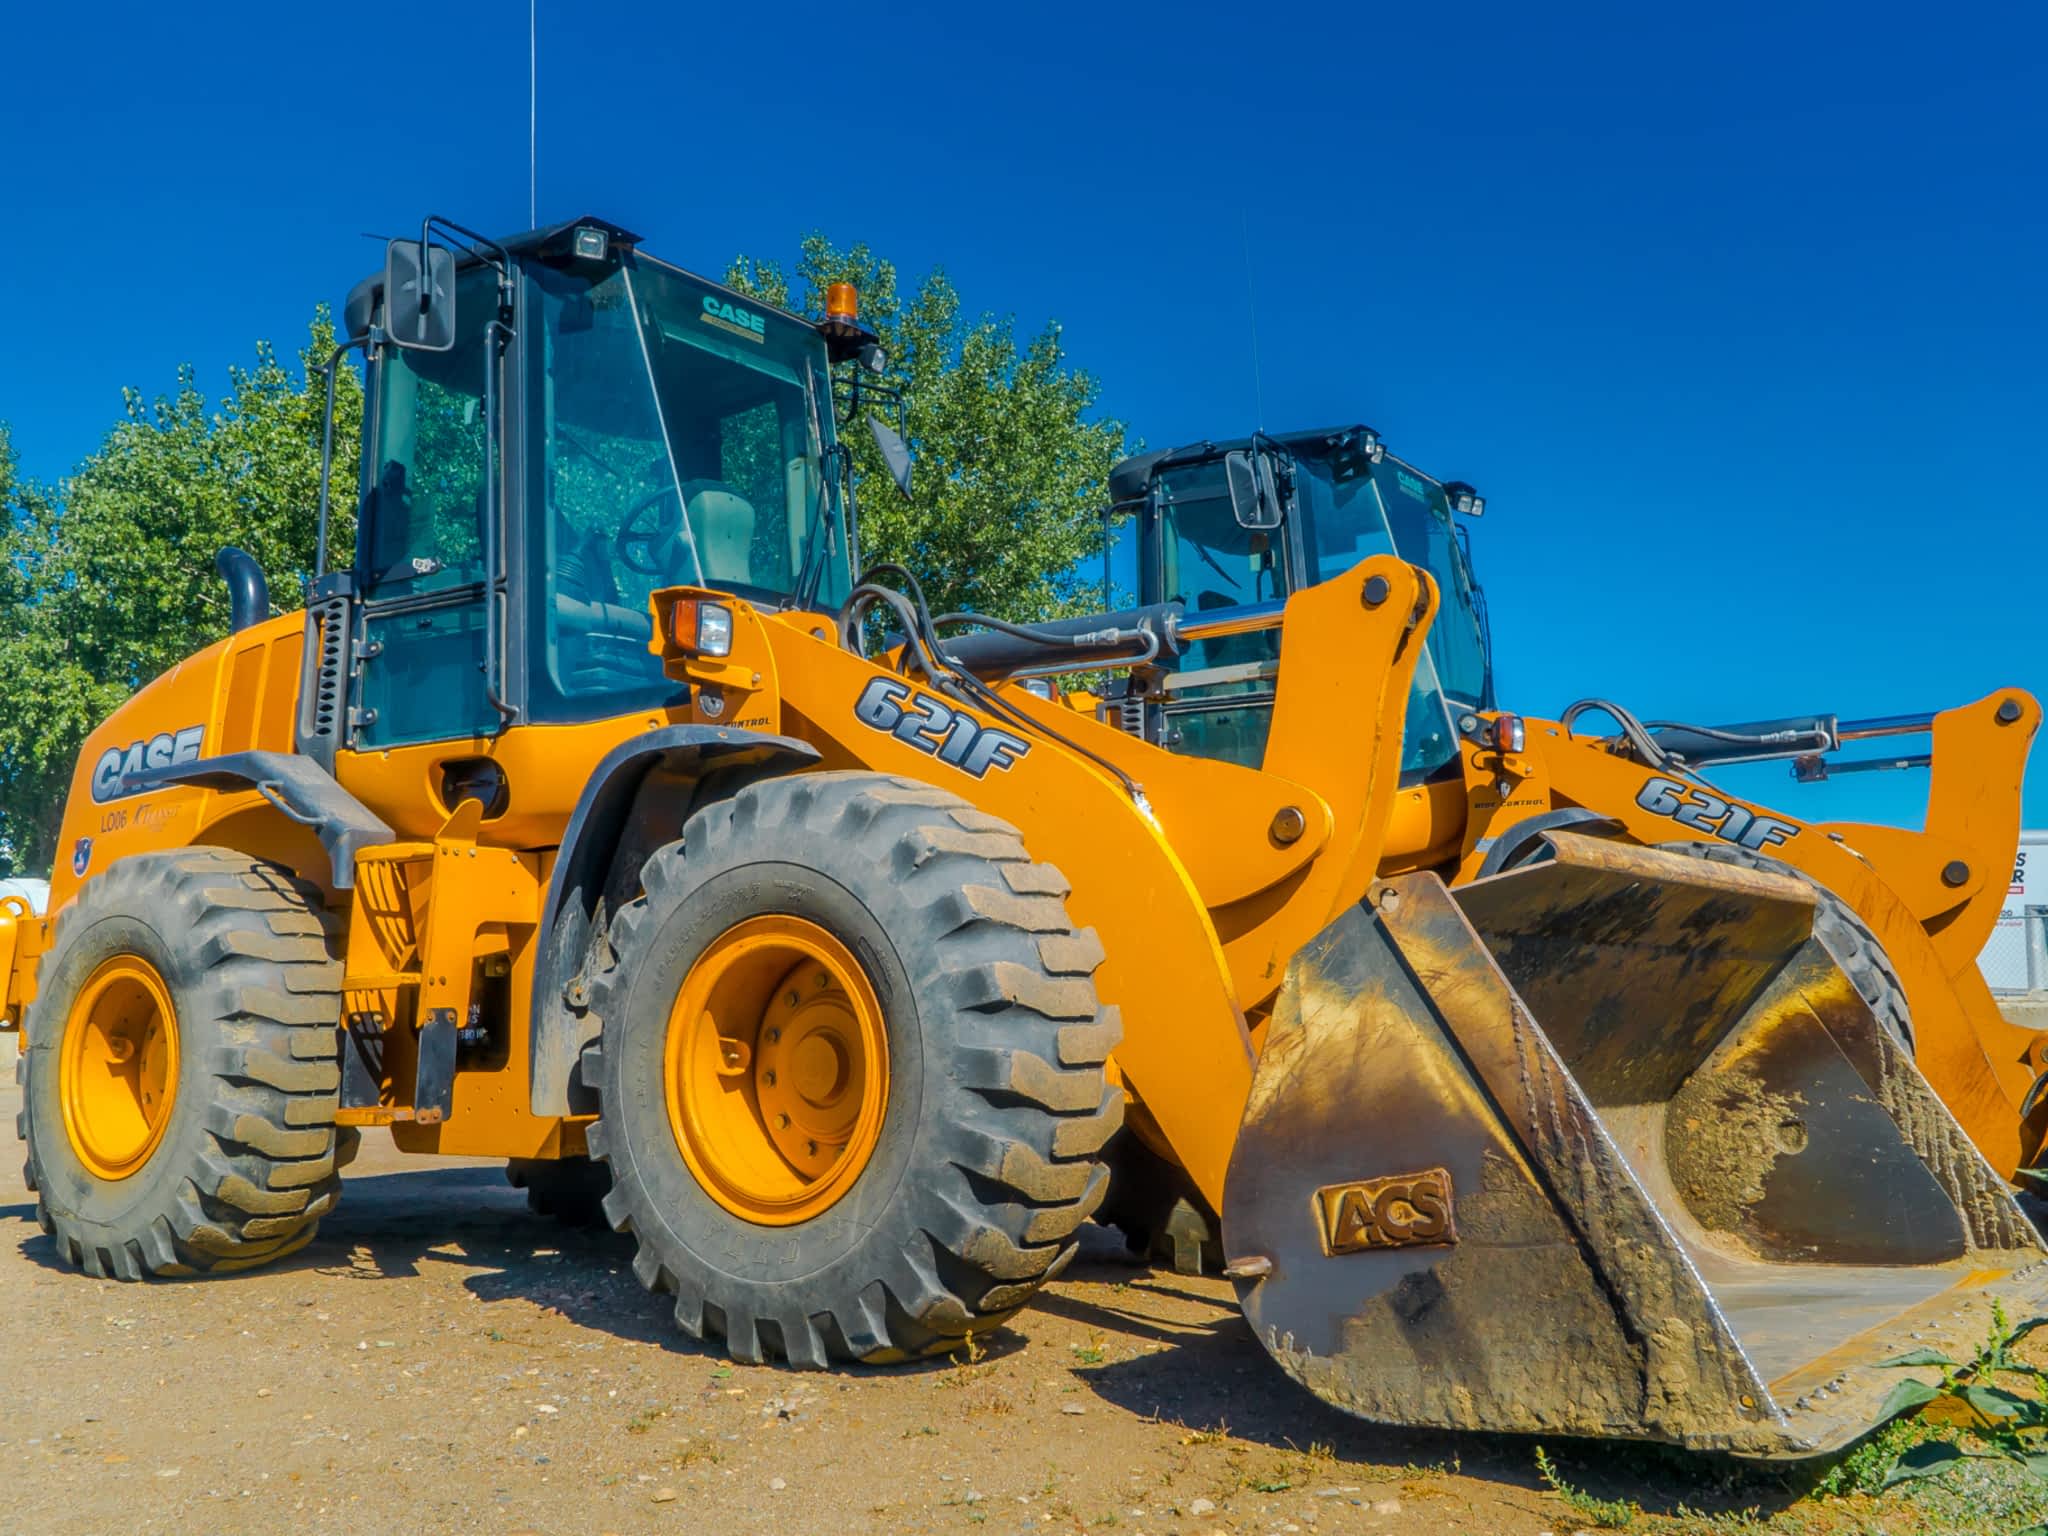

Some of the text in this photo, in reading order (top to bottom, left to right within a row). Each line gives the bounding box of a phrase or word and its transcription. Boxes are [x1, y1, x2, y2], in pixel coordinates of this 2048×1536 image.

[703, 296, 765, 334] CASE
[92, 725, 206, 803] CASE
[854, 676, 1032, 780] 621F
[1635, 777, 1800, 851] 621F
[1334, 1180, 1447, 1249] ACS
